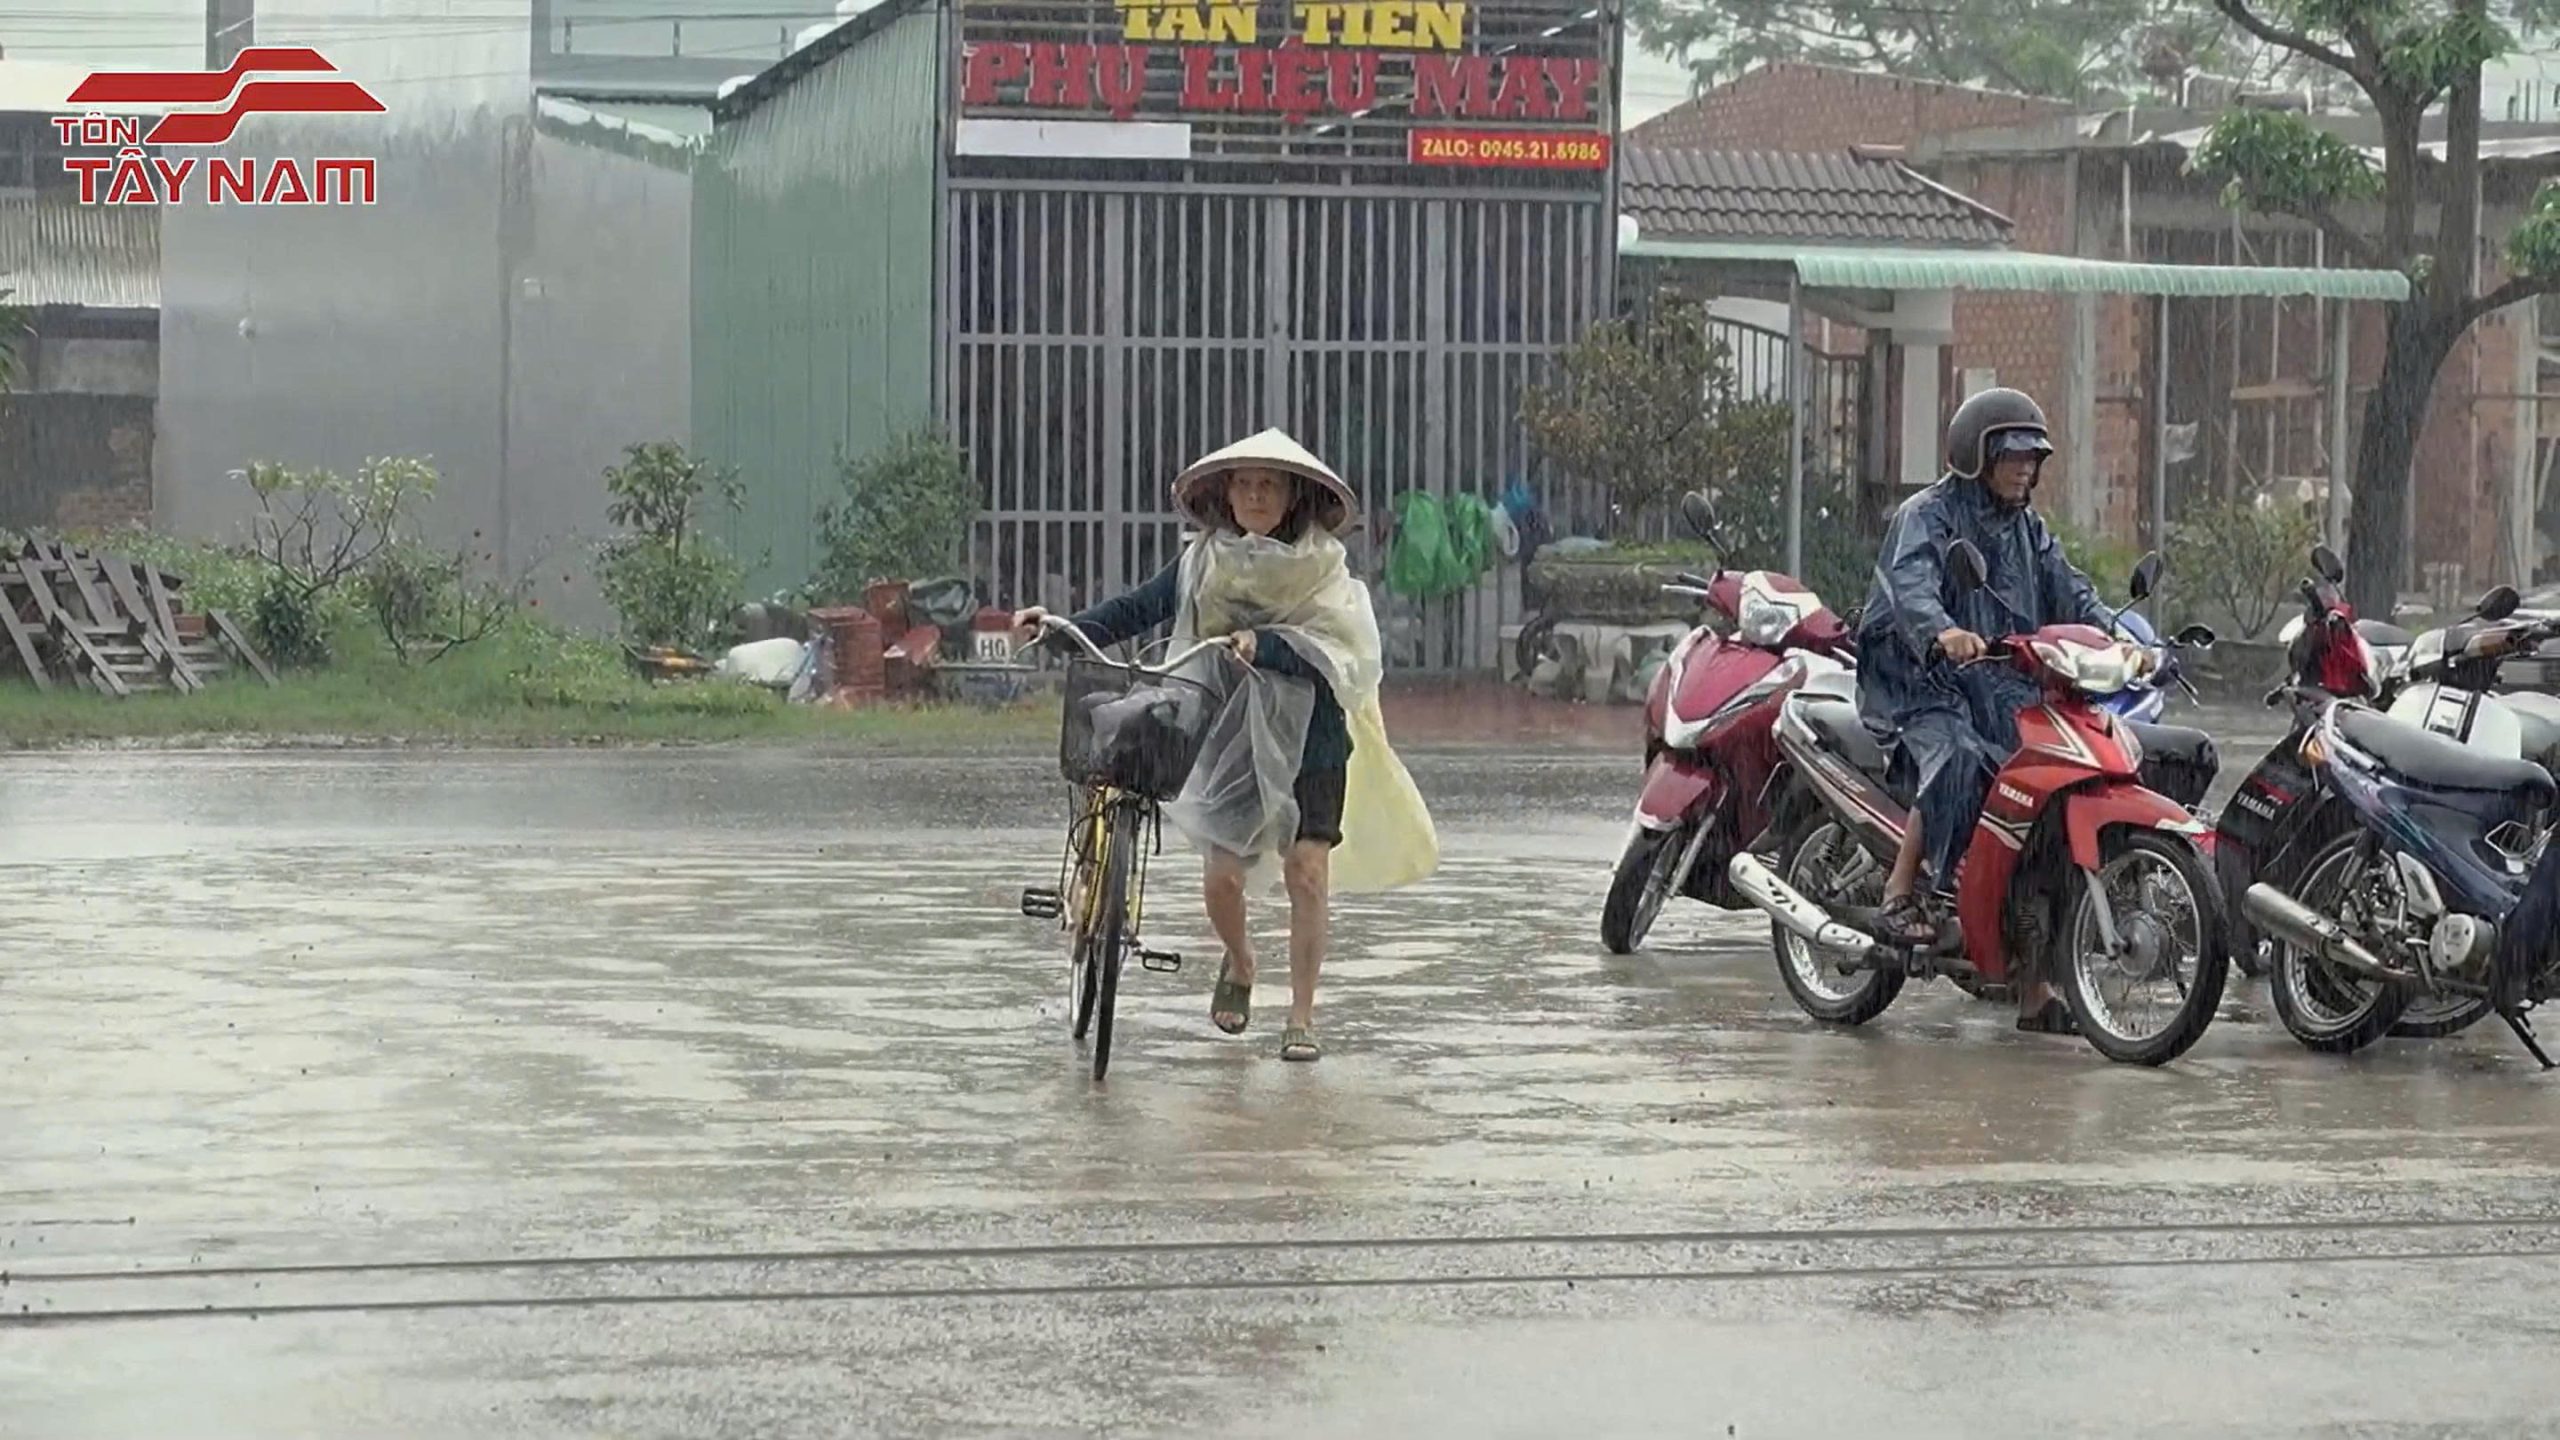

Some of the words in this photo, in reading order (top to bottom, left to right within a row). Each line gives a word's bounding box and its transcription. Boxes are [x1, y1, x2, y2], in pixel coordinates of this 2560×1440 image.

[961, 43, 1149, 121] PHỤ
[1178, 36, 1380, 123] LIỆU
[1409, 54, 1600, 119] MAY
[1421, 139, 1475, 159] ZALO:
